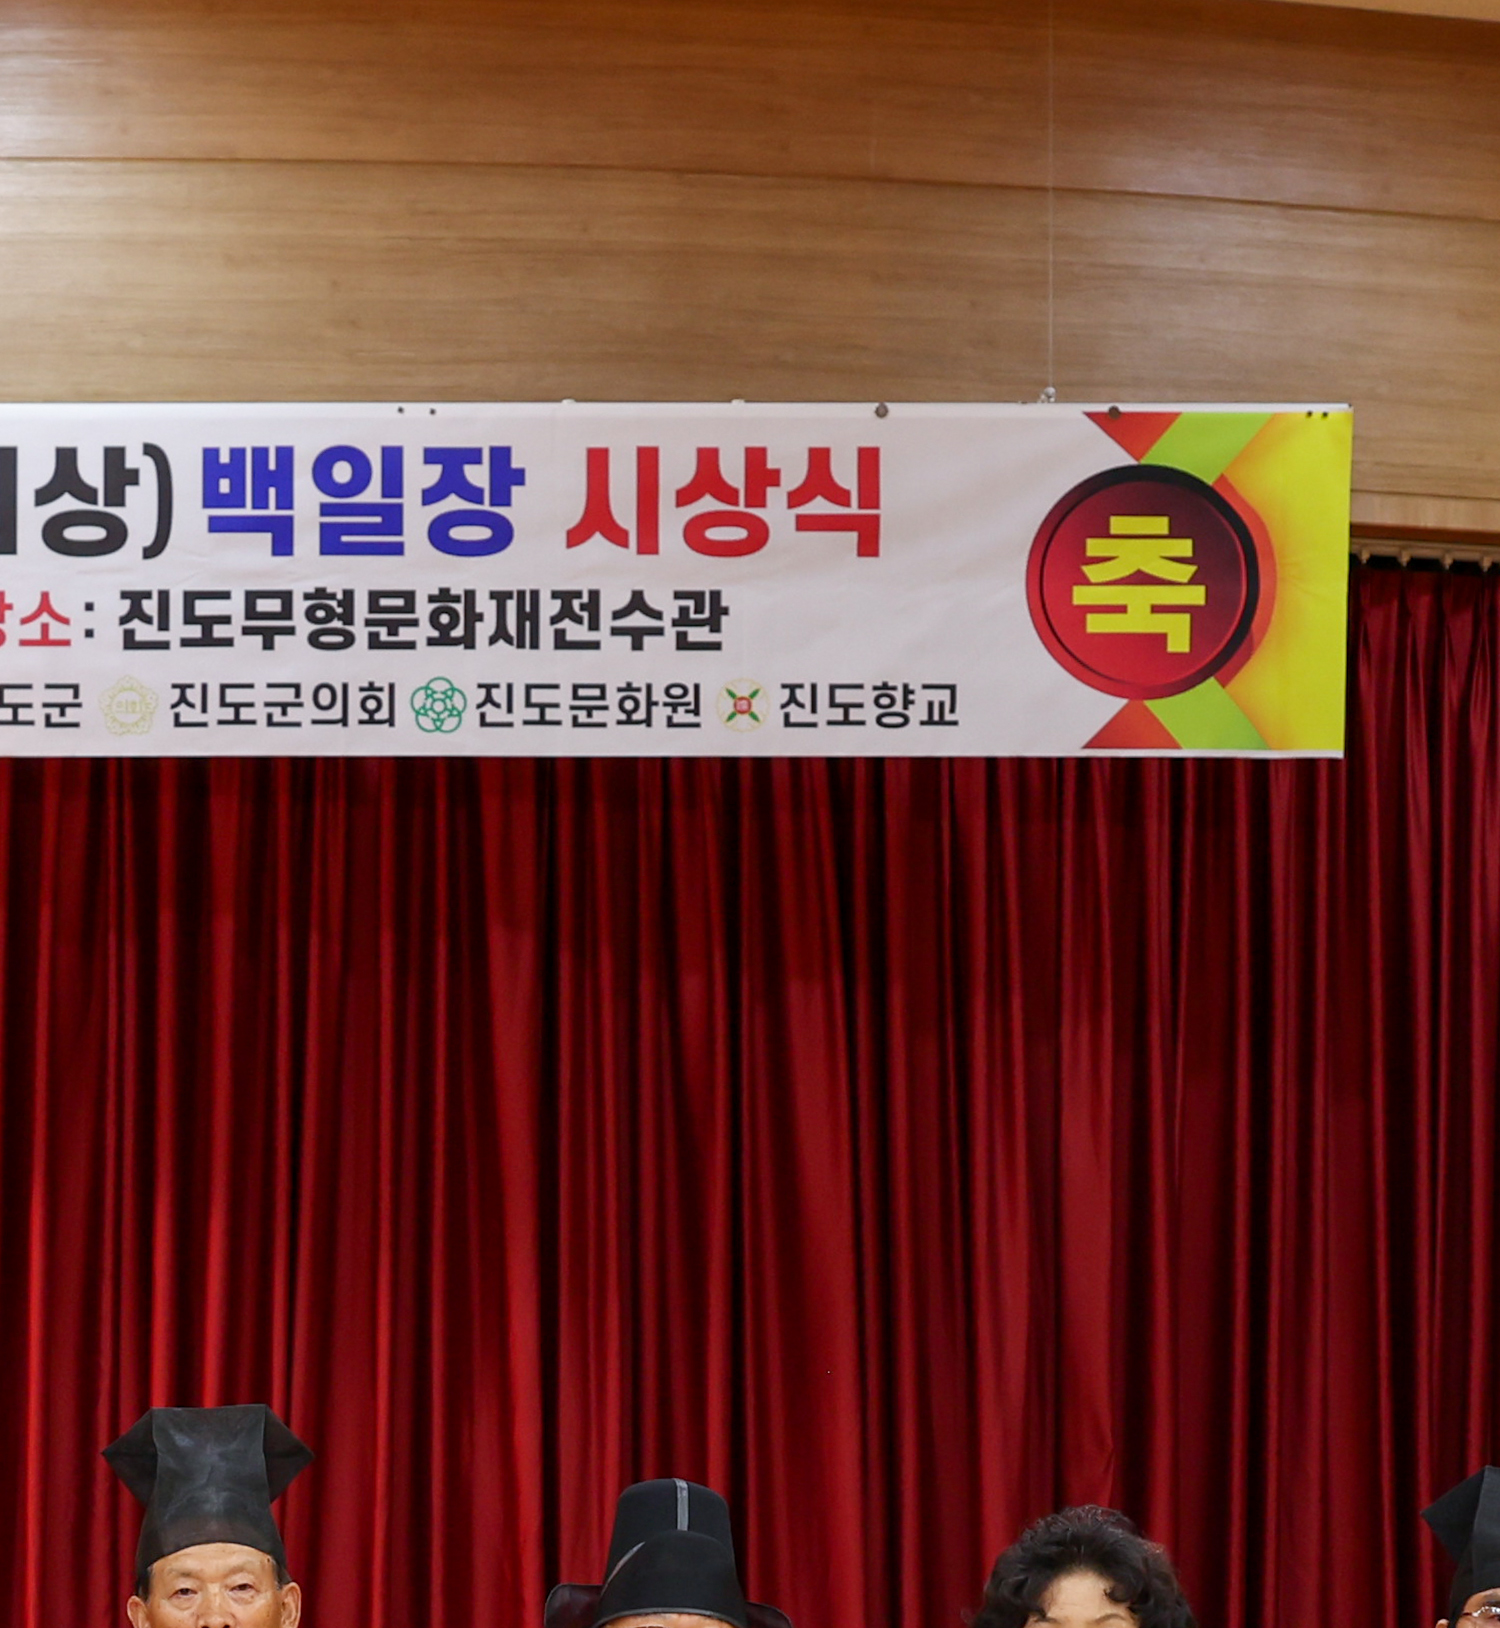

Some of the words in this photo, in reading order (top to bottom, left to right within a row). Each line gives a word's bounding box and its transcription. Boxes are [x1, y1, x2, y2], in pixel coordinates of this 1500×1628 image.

[202, 445, 525, 557] 백일장
[566, 447, 880, 557] 시상식
[119, 587, 729, 651] 진도무형문화재전수관
[1073, 516, 1205, 652] 축
[171, 681, 395, 728] 진도군의회
[476, 682, 701, 728] 진도문화원
[780, 682, 959, 728] 진도향교
